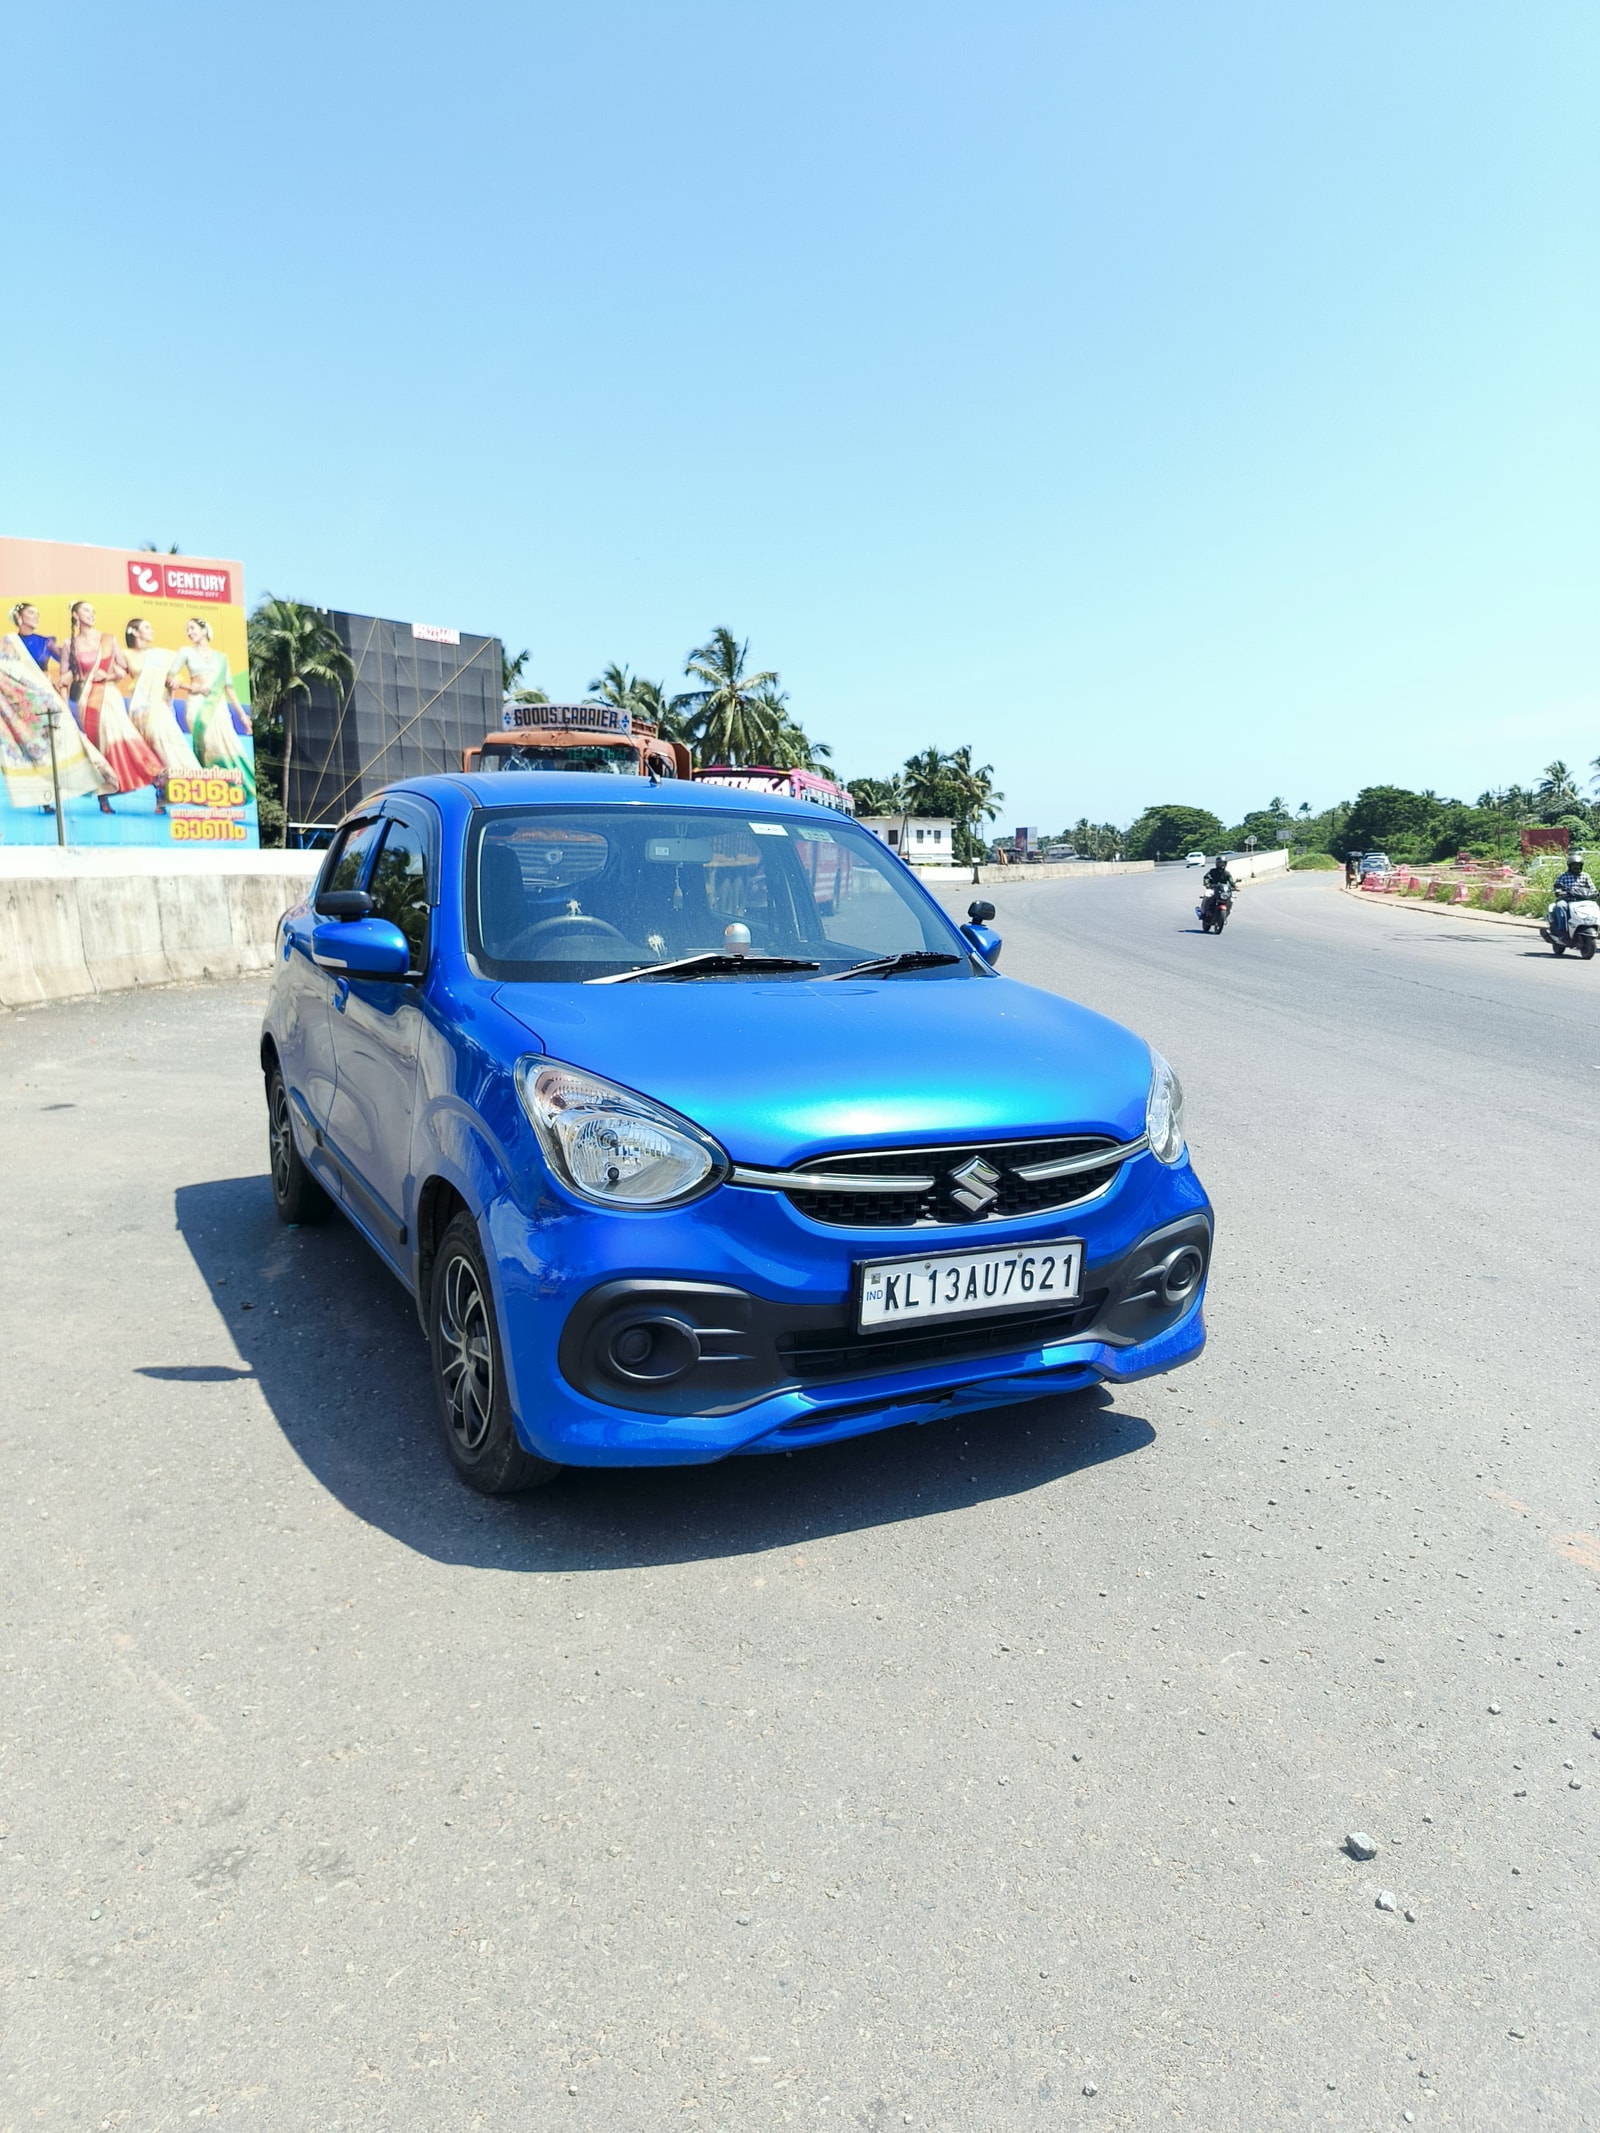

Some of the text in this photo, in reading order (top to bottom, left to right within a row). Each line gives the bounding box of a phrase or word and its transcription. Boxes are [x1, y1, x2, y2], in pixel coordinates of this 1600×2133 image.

[167, 571, 226, 592] CENTURY
[514, 707, 619, 729] GOODS CARRIER
[694, 777, 791, 798] THIKA
[884, 1253, 1073, 1311] KL13AU7621
[866, 1289, 883, 1301] IND
